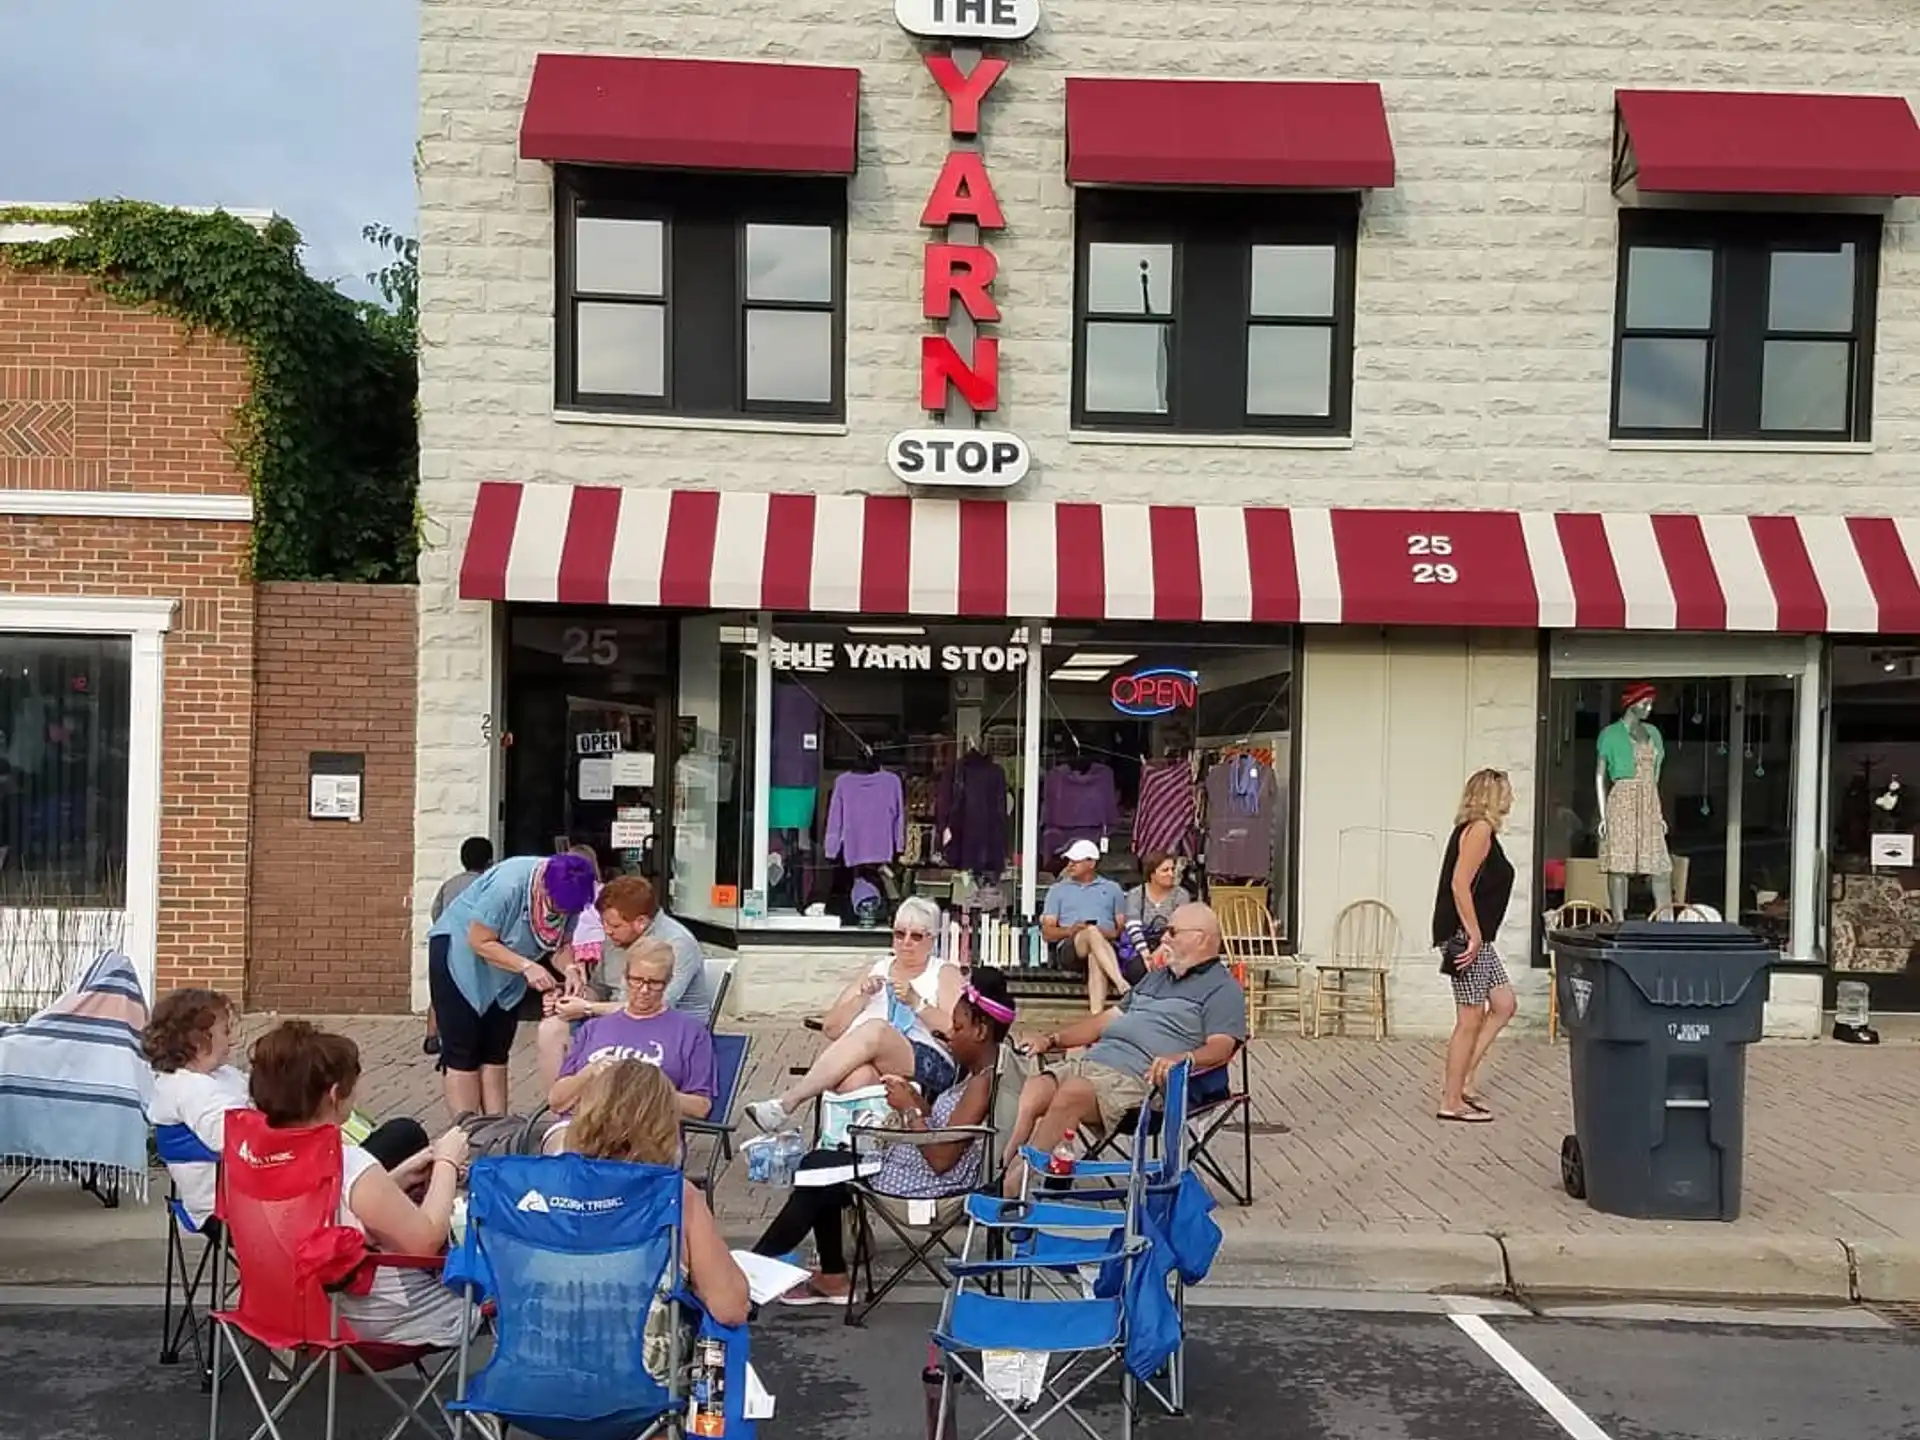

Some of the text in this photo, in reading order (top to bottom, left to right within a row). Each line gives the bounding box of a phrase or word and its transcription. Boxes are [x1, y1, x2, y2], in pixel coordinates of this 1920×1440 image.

[920, 55, 1009, 413] YARN
[897, 440, 1020, 474] STOP
[1407, 534, 1453, 556] 25
[1412, 562, 1459, 584] 29
[562, 627, 618, 666] 25
[843, 644, 932, 670] YARN
[941, 645, 1028, 672] STOP
[1111, 676, 1196, 708] OPEN
[581, 733, 618, 752] OPEN
